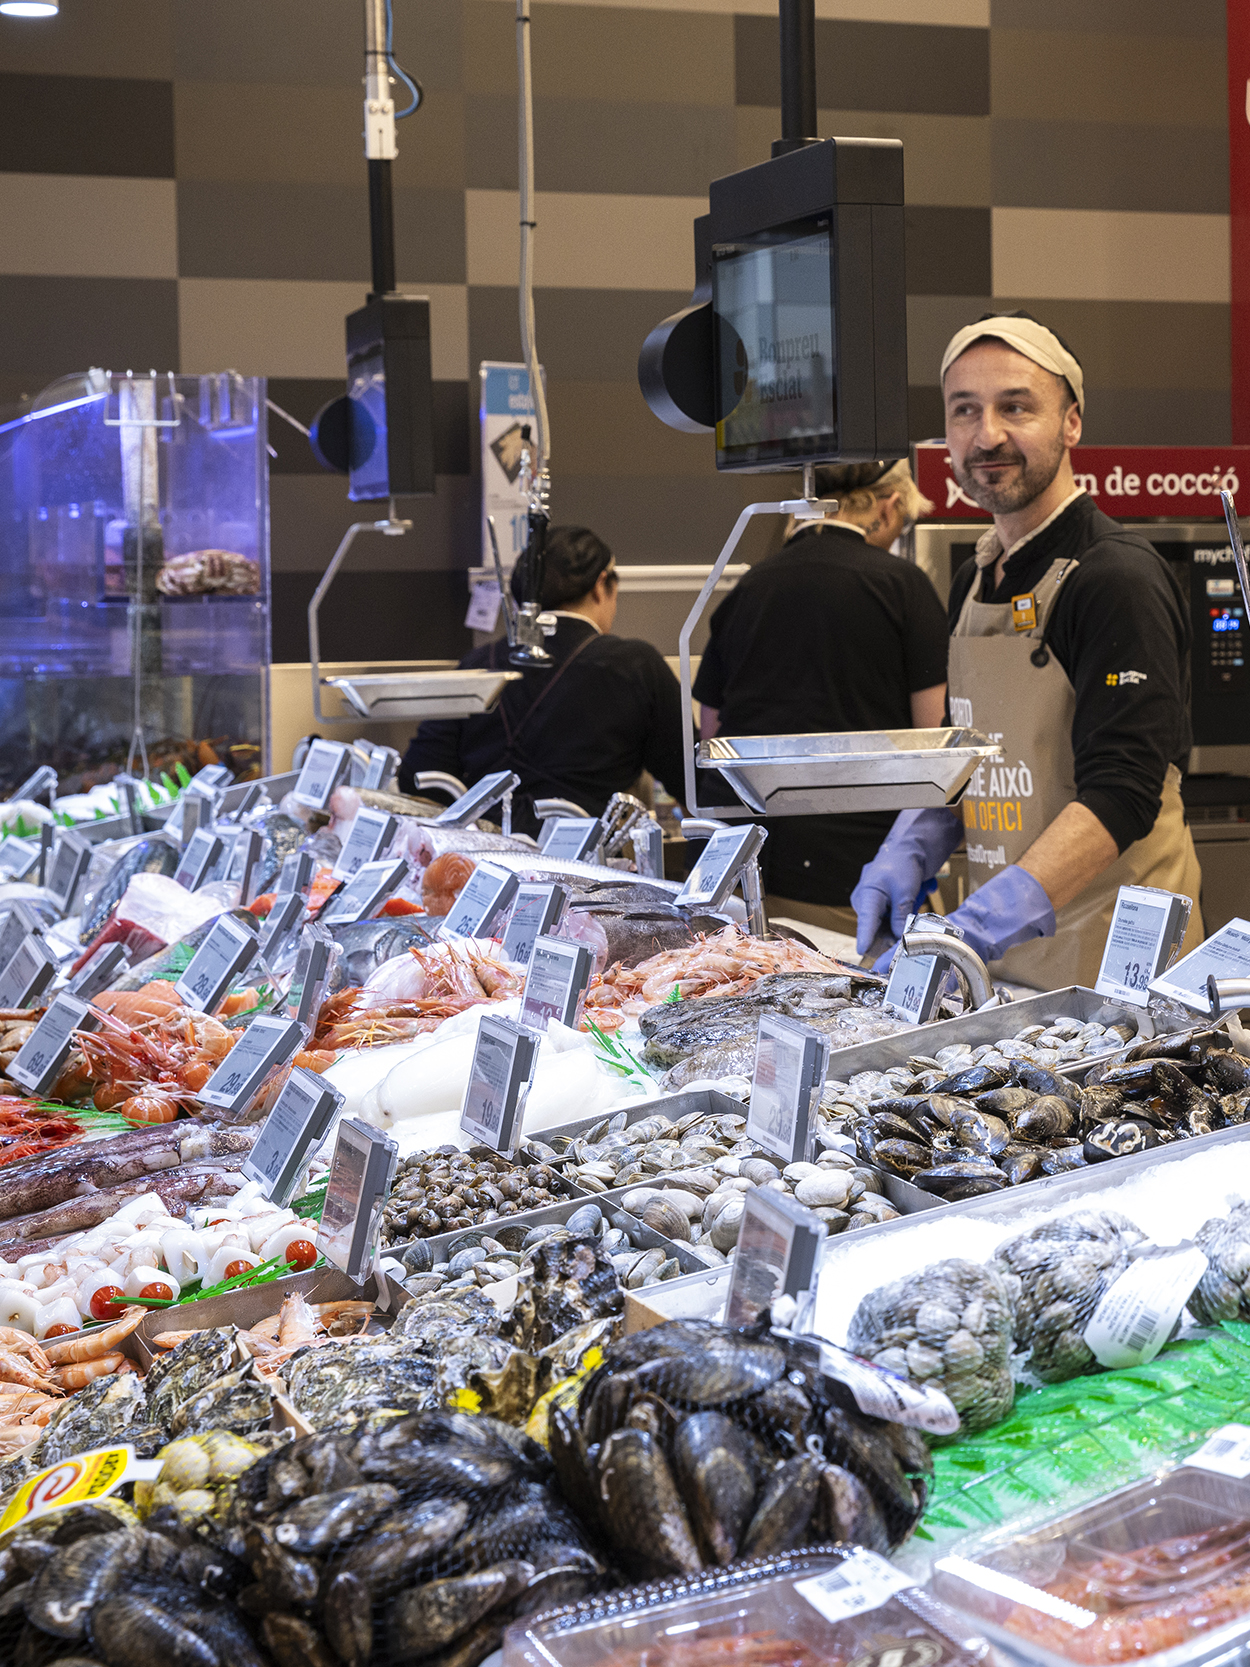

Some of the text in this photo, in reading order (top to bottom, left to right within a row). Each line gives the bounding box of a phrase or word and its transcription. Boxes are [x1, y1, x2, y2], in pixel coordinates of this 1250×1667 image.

[1105, 466, 1141, 496] de
[1146, 465, 1240, 496] cocció
[989, 760, 1034, 797] AIXÒ
[979, 801, 1022, 832] OFICI
